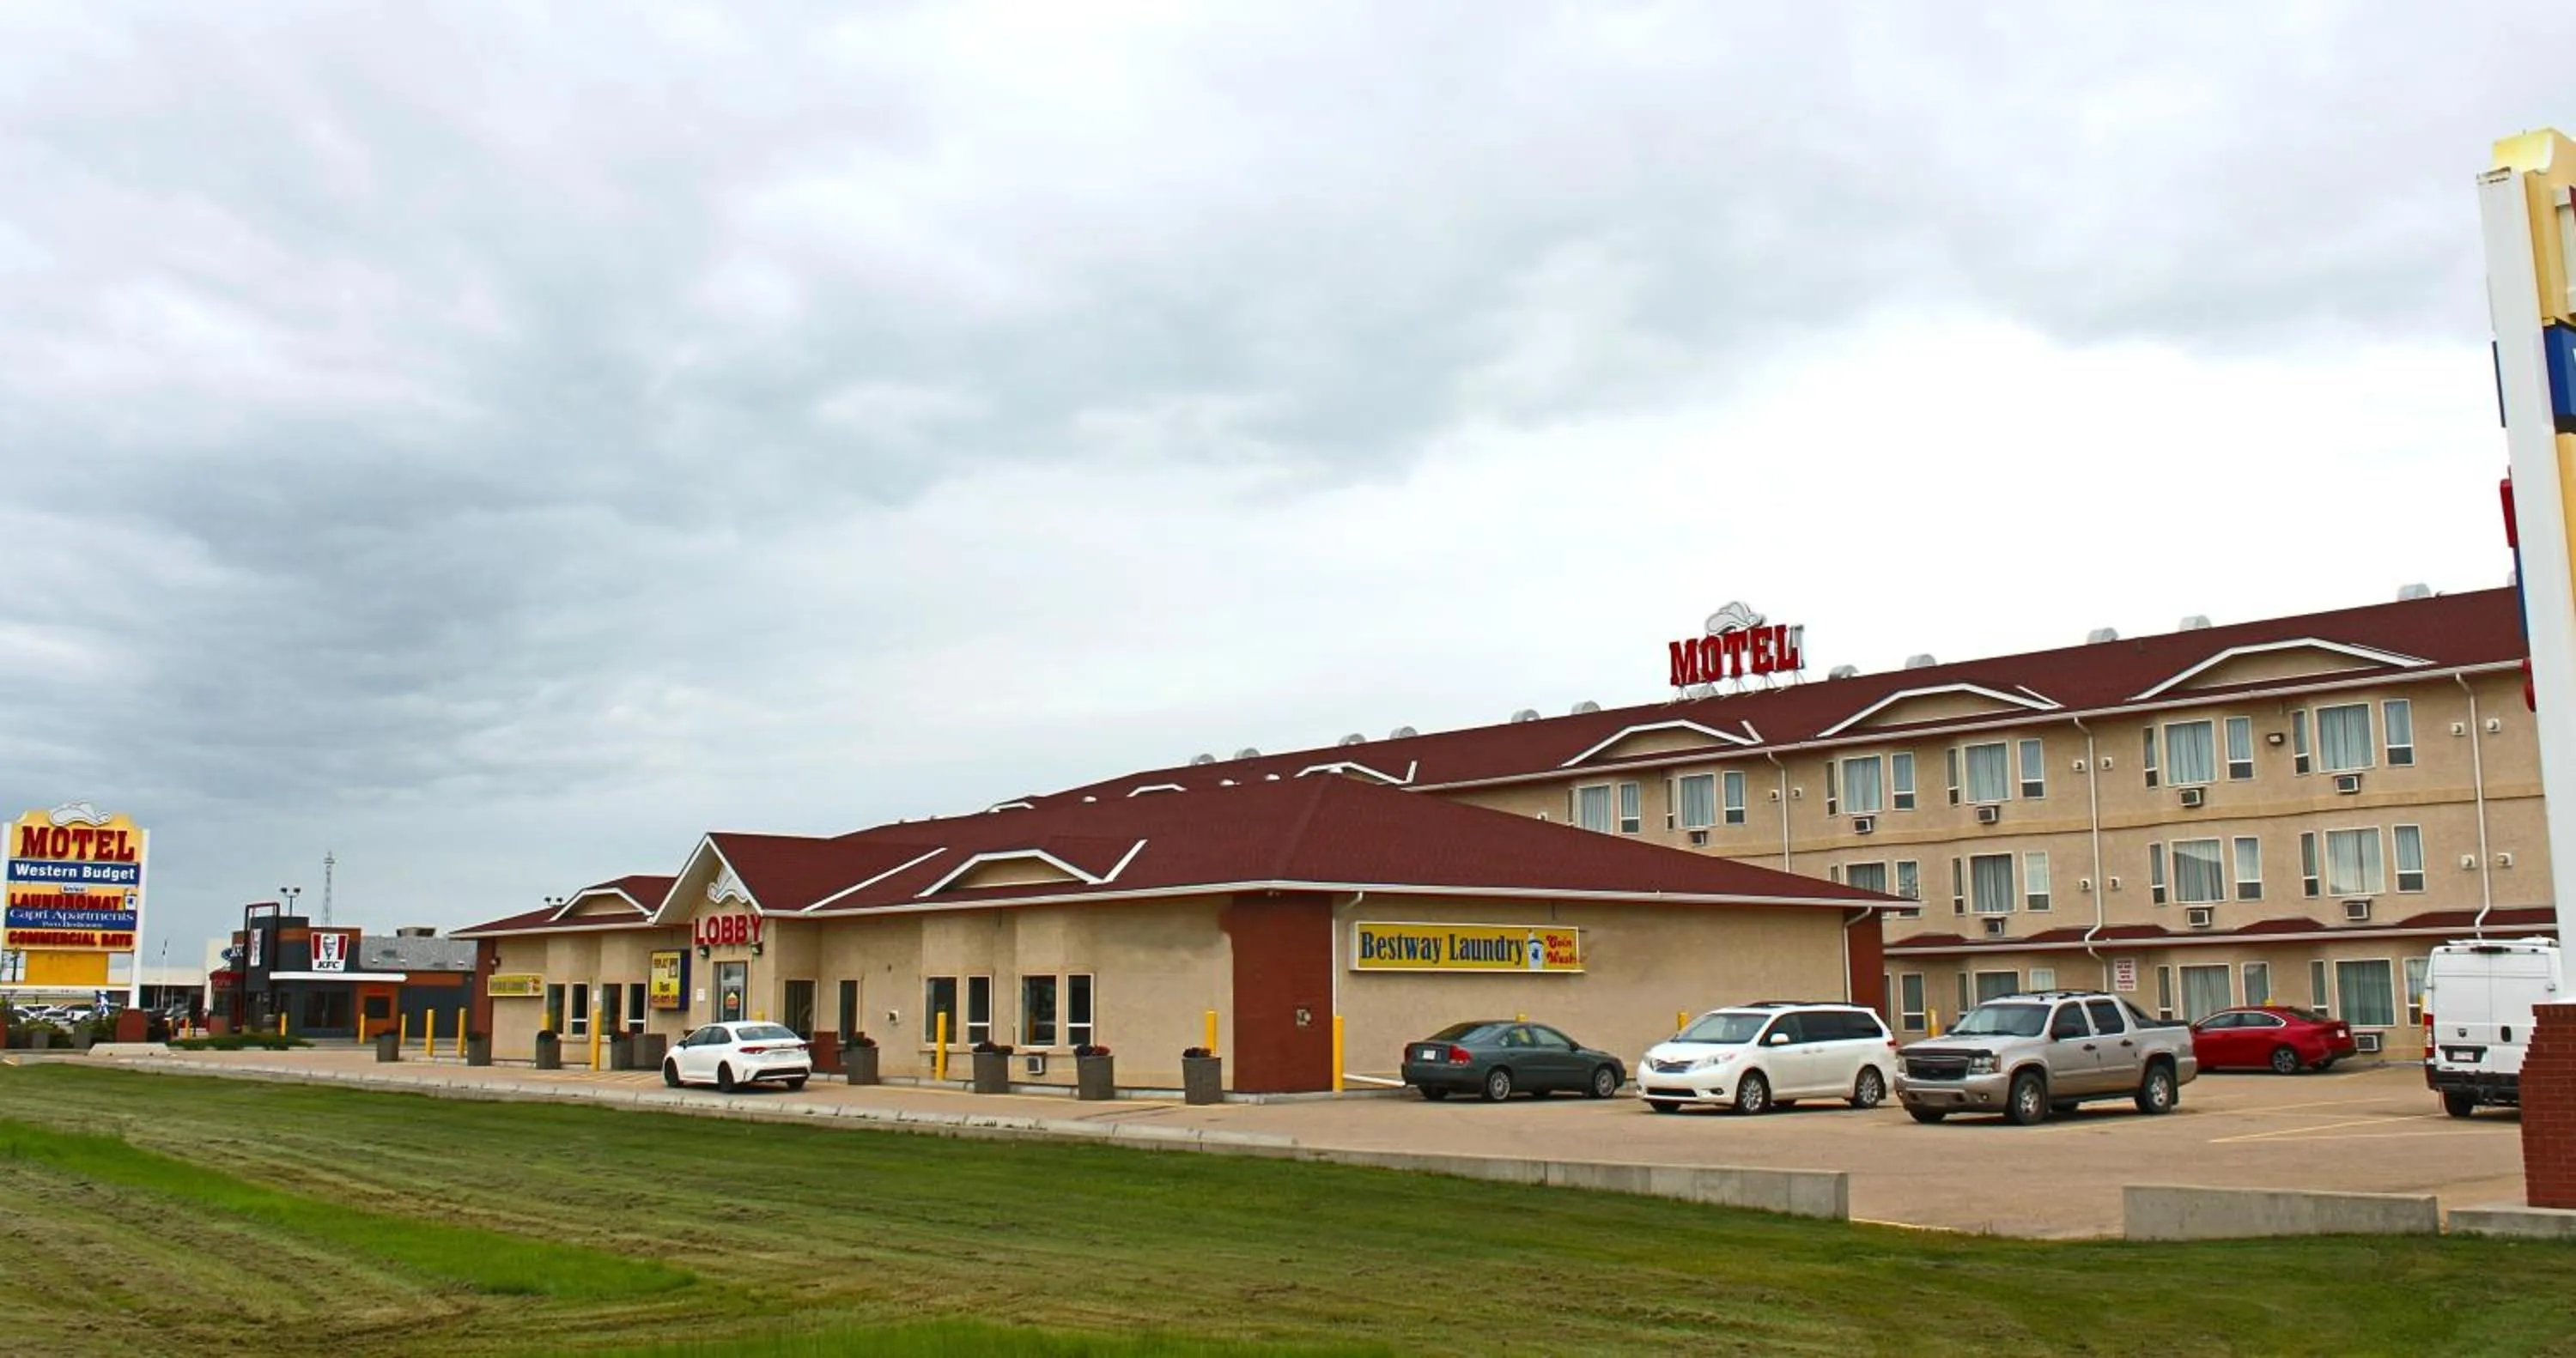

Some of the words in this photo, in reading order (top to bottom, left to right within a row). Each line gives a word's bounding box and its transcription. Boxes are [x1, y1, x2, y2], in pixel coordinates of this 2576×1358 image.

[1669, 624, 1798, 687] MOTEL
[21, 826, 135, 861] MOTEL
[15, 863, 77, 878] Western
[82, 866, 135, 882] Budget
[9, 909, 47, 920] Capri
[52, 910, 134, 922] Apartments
[9, 931, 96, 946] COMMERCIAL
[100, 933, 133, 947] BAYS
[695, 914, 762, 945] LOBBY
[1360, 931, 1443, 964] Bestway
[1449, 933, 1524, 965] Laundry
[317, 961, 340, 969] KFC
